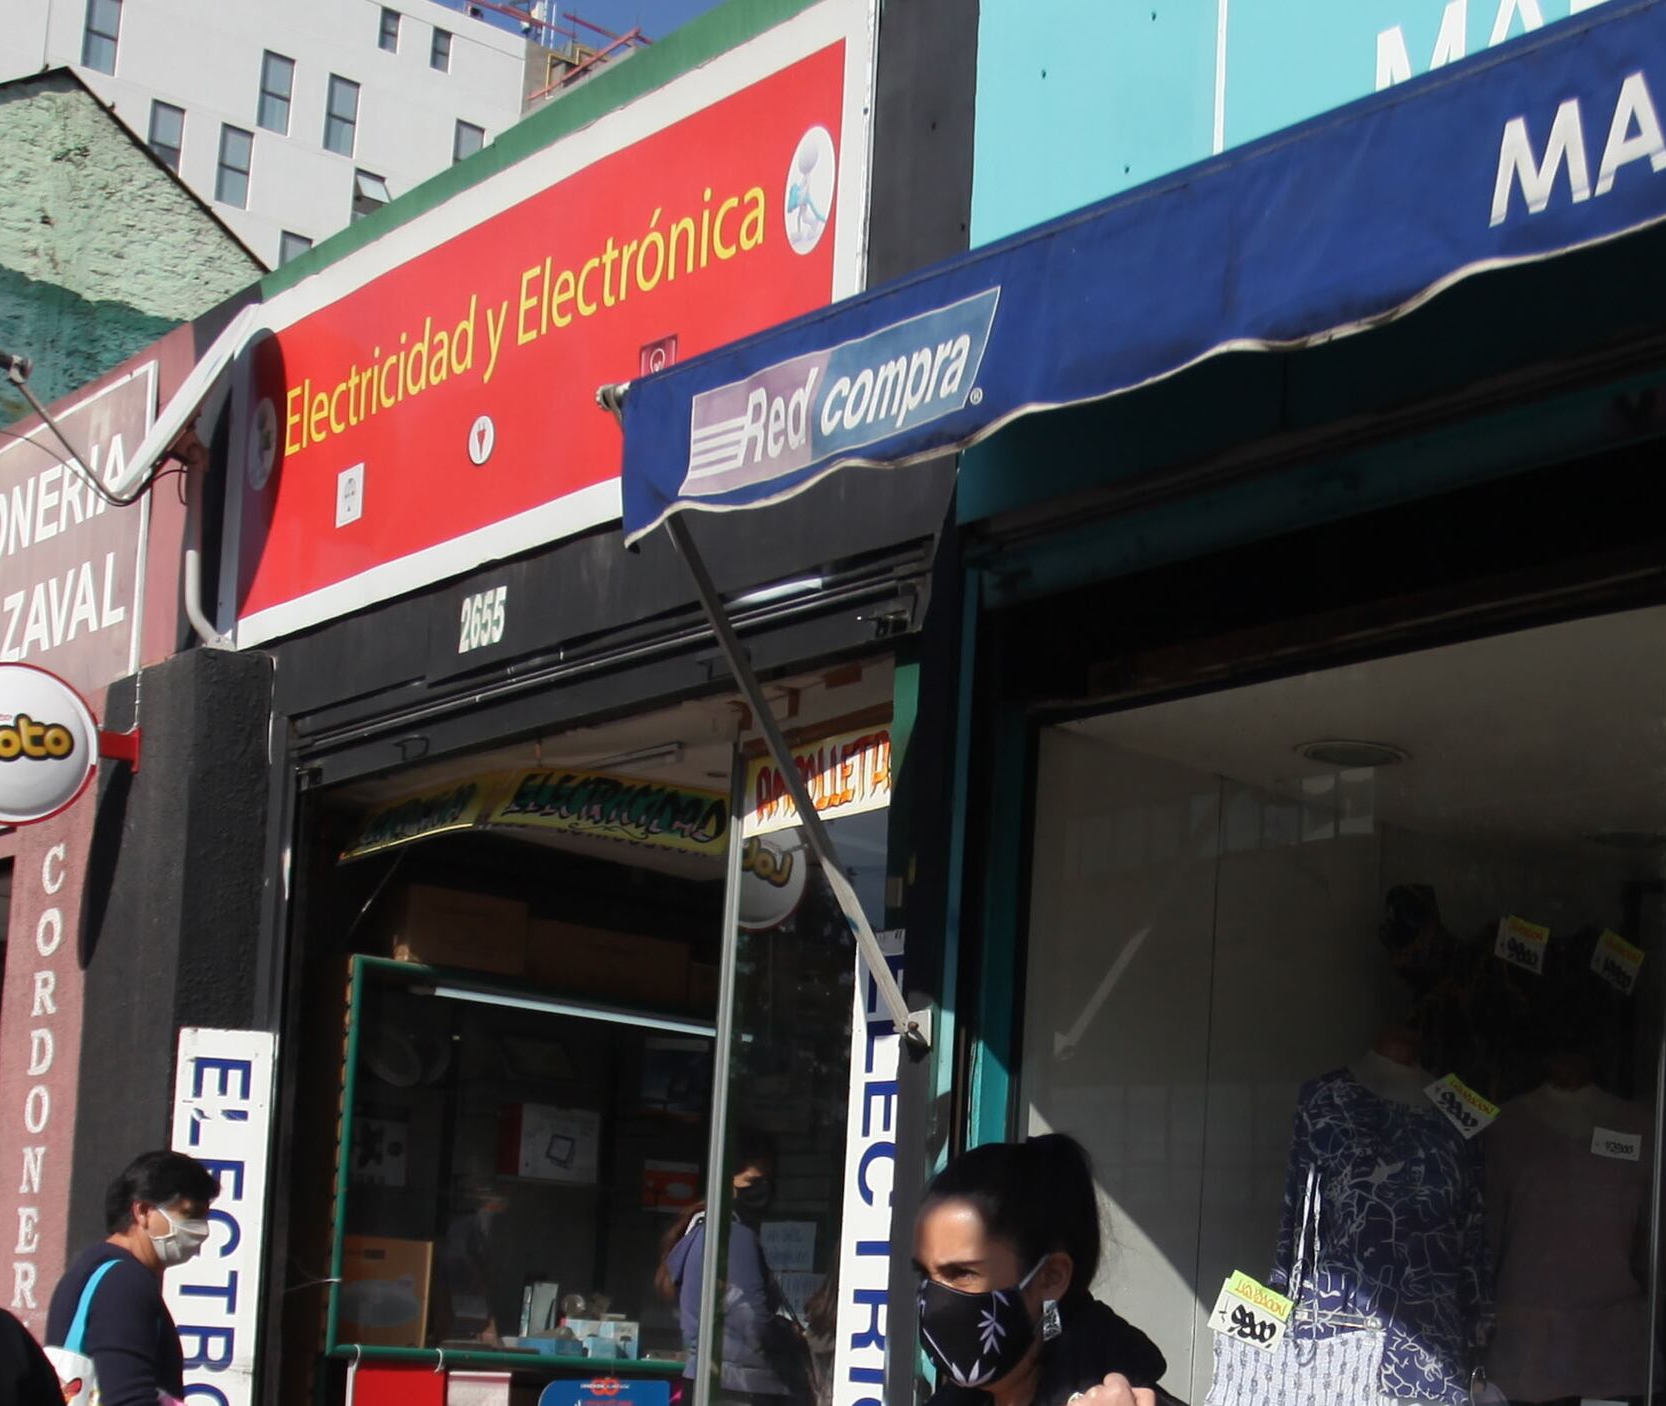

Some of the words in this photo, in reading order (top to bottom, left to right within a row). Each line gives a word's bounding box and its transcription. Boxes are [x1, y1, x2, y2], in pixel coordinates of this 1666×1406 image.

[284, 294, 477, 457] Electricidad
[484, 300, 509, 383] y
[517, 187, 766, 346] Electrónica
[738, 366, 819, 467] Red
[820, 334, 970, 436] compra
[458, 585, 508, 655] 2655
